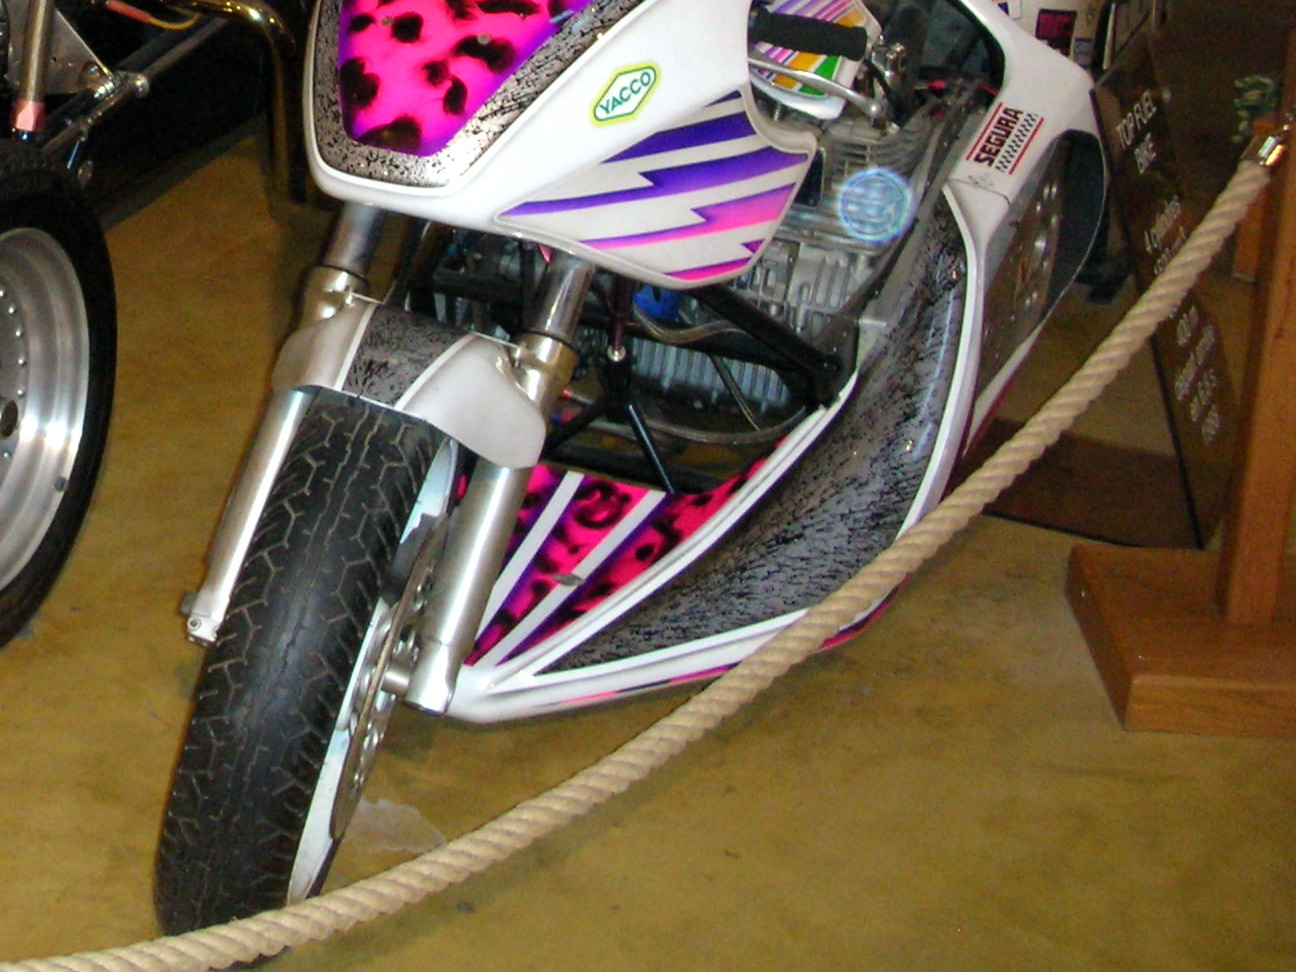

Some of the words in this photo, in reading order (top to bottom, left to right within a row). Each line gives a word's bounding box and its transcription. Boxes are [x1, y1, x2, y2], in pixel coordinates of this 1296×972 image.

[599, 71, 652, 115] YACCO
[973, 107, 1024, 168] SEGURA
[1115, 111, 1136, 151] TOP
[1133, 89, 1158, 131] FUEL
[1134, 132, 1158, 175] BIKE
